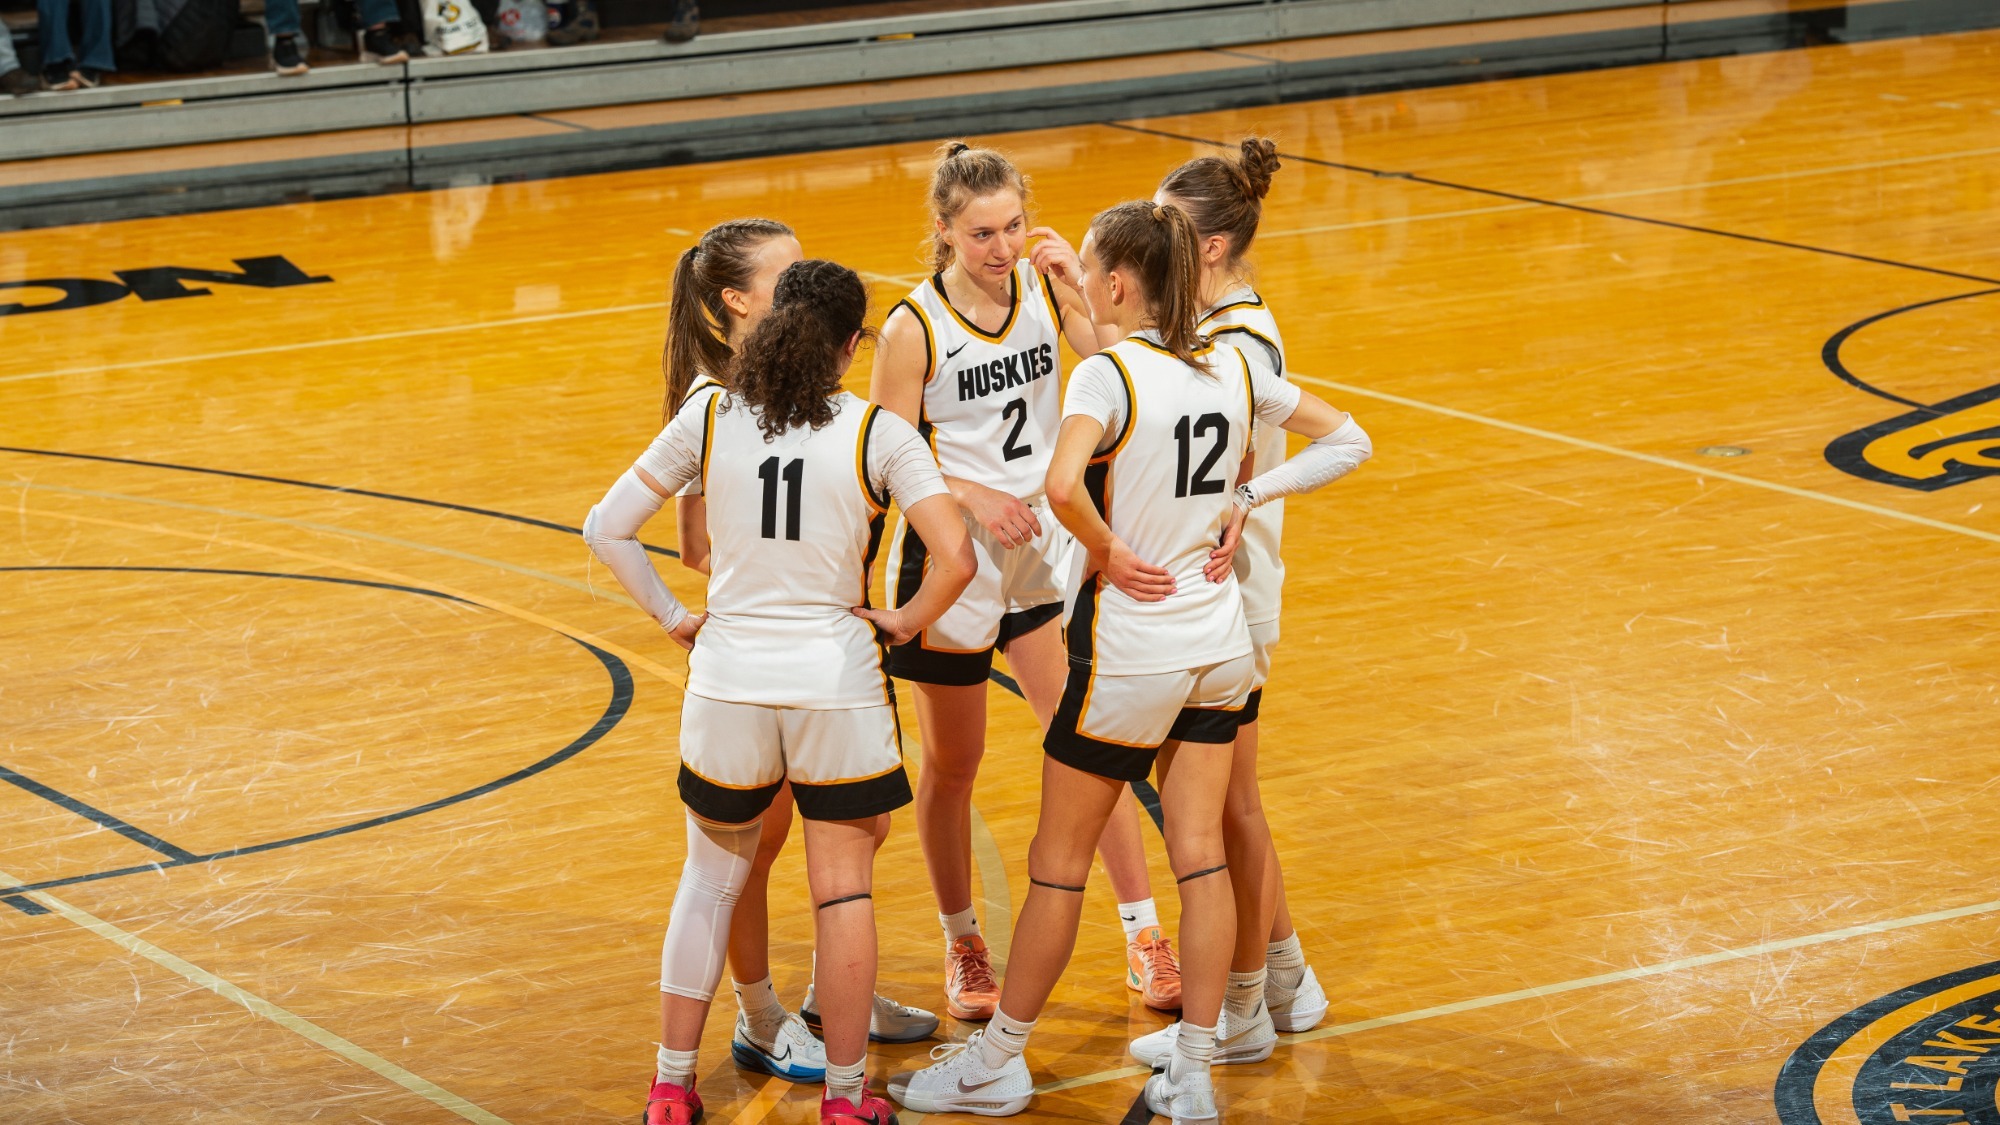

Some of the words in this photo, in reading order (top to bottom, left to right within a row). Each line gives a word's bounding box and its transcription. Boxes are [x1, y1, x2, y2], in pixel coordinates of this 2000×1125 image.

[957, 342, 1053, 402] HUSKIES
[1001, 397, 1032, 463] 2
[1173, 411, 1230, 499] 12
[757, 455, 804, 542] 11
[1889, 1004, 2000, 1092] LAKE
